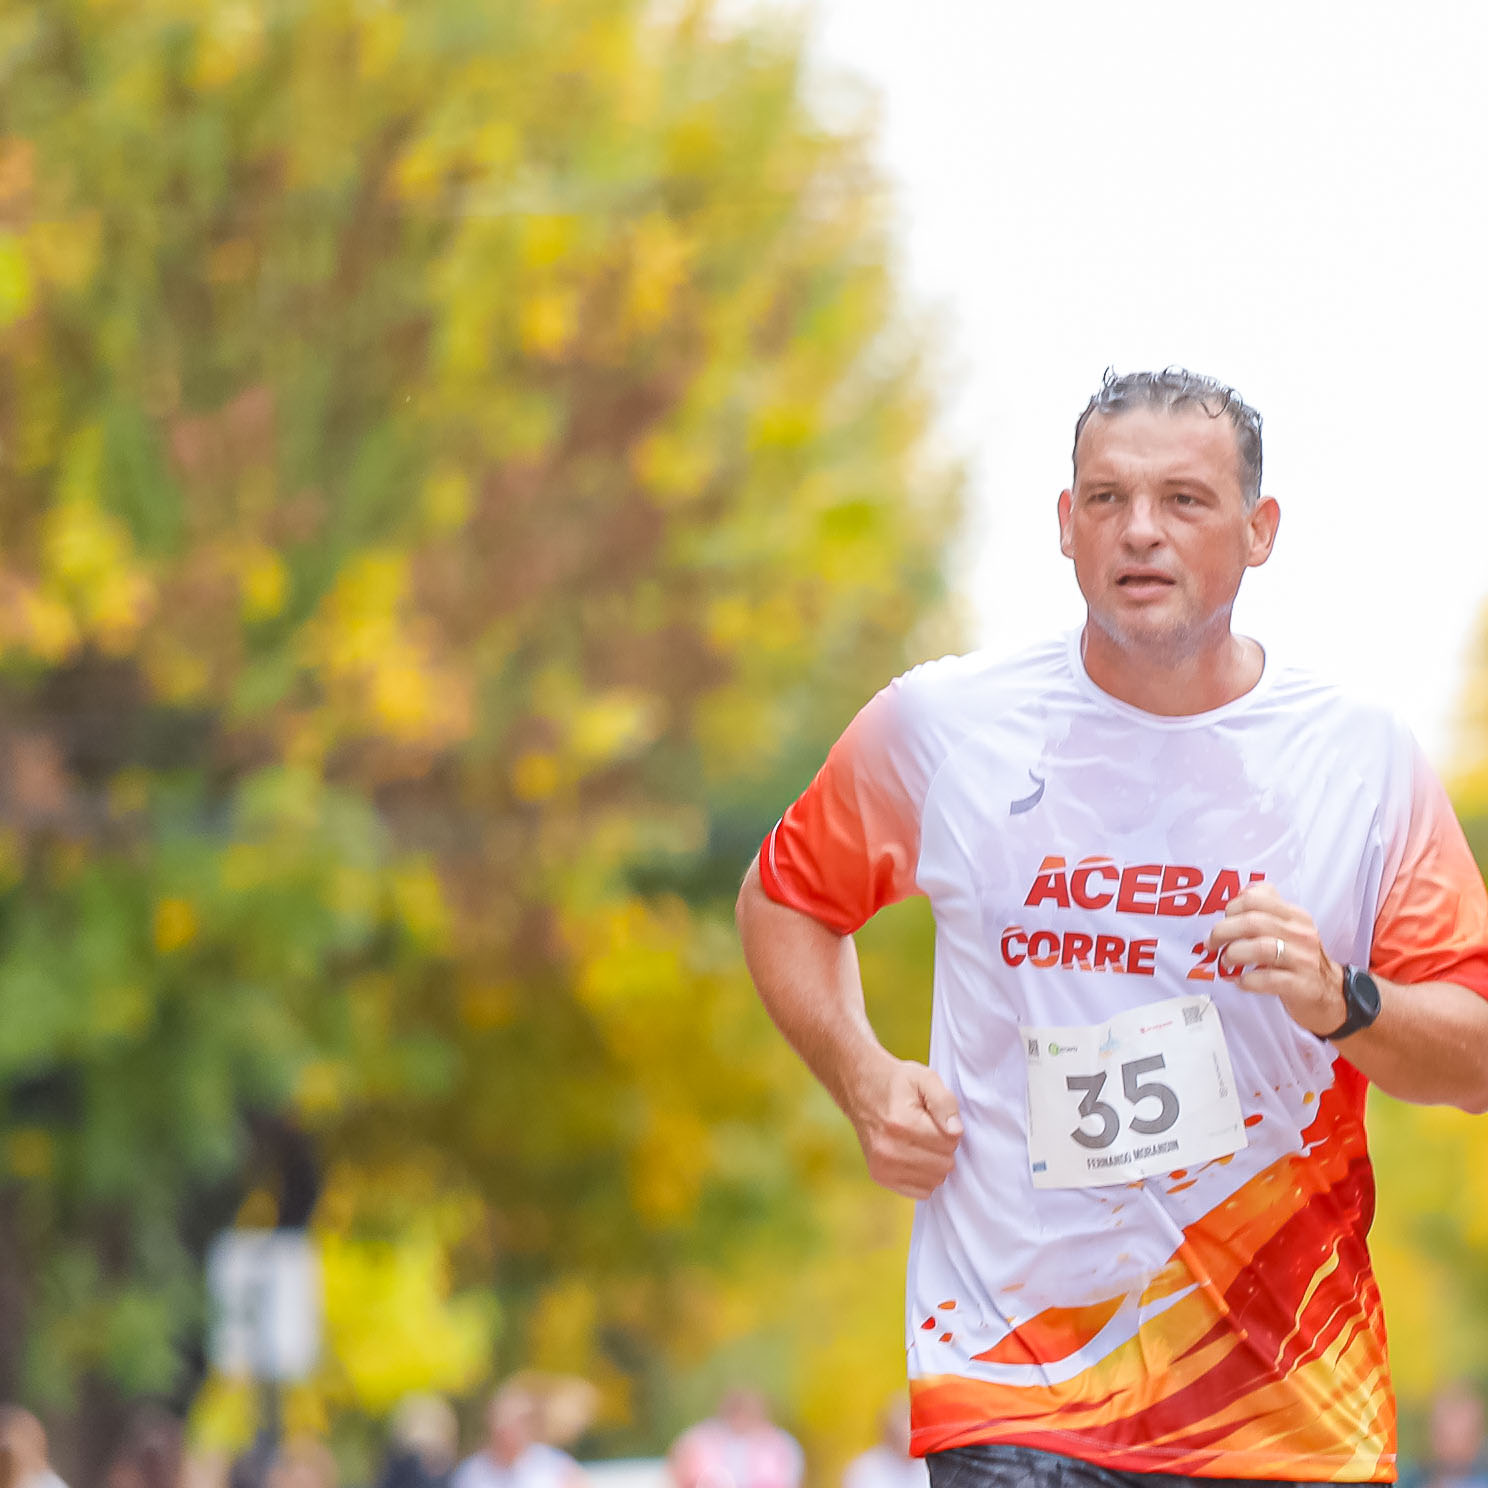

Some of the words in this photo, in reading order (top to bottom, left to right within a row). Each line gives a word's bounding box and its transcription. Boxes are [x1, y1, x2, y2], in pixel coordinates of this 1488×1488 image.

[1023, 855, 1266, 917] ACEBA
[1000, 925, 1159, 976] CORRE
[1065, 1053, 1180, 1149] 35
